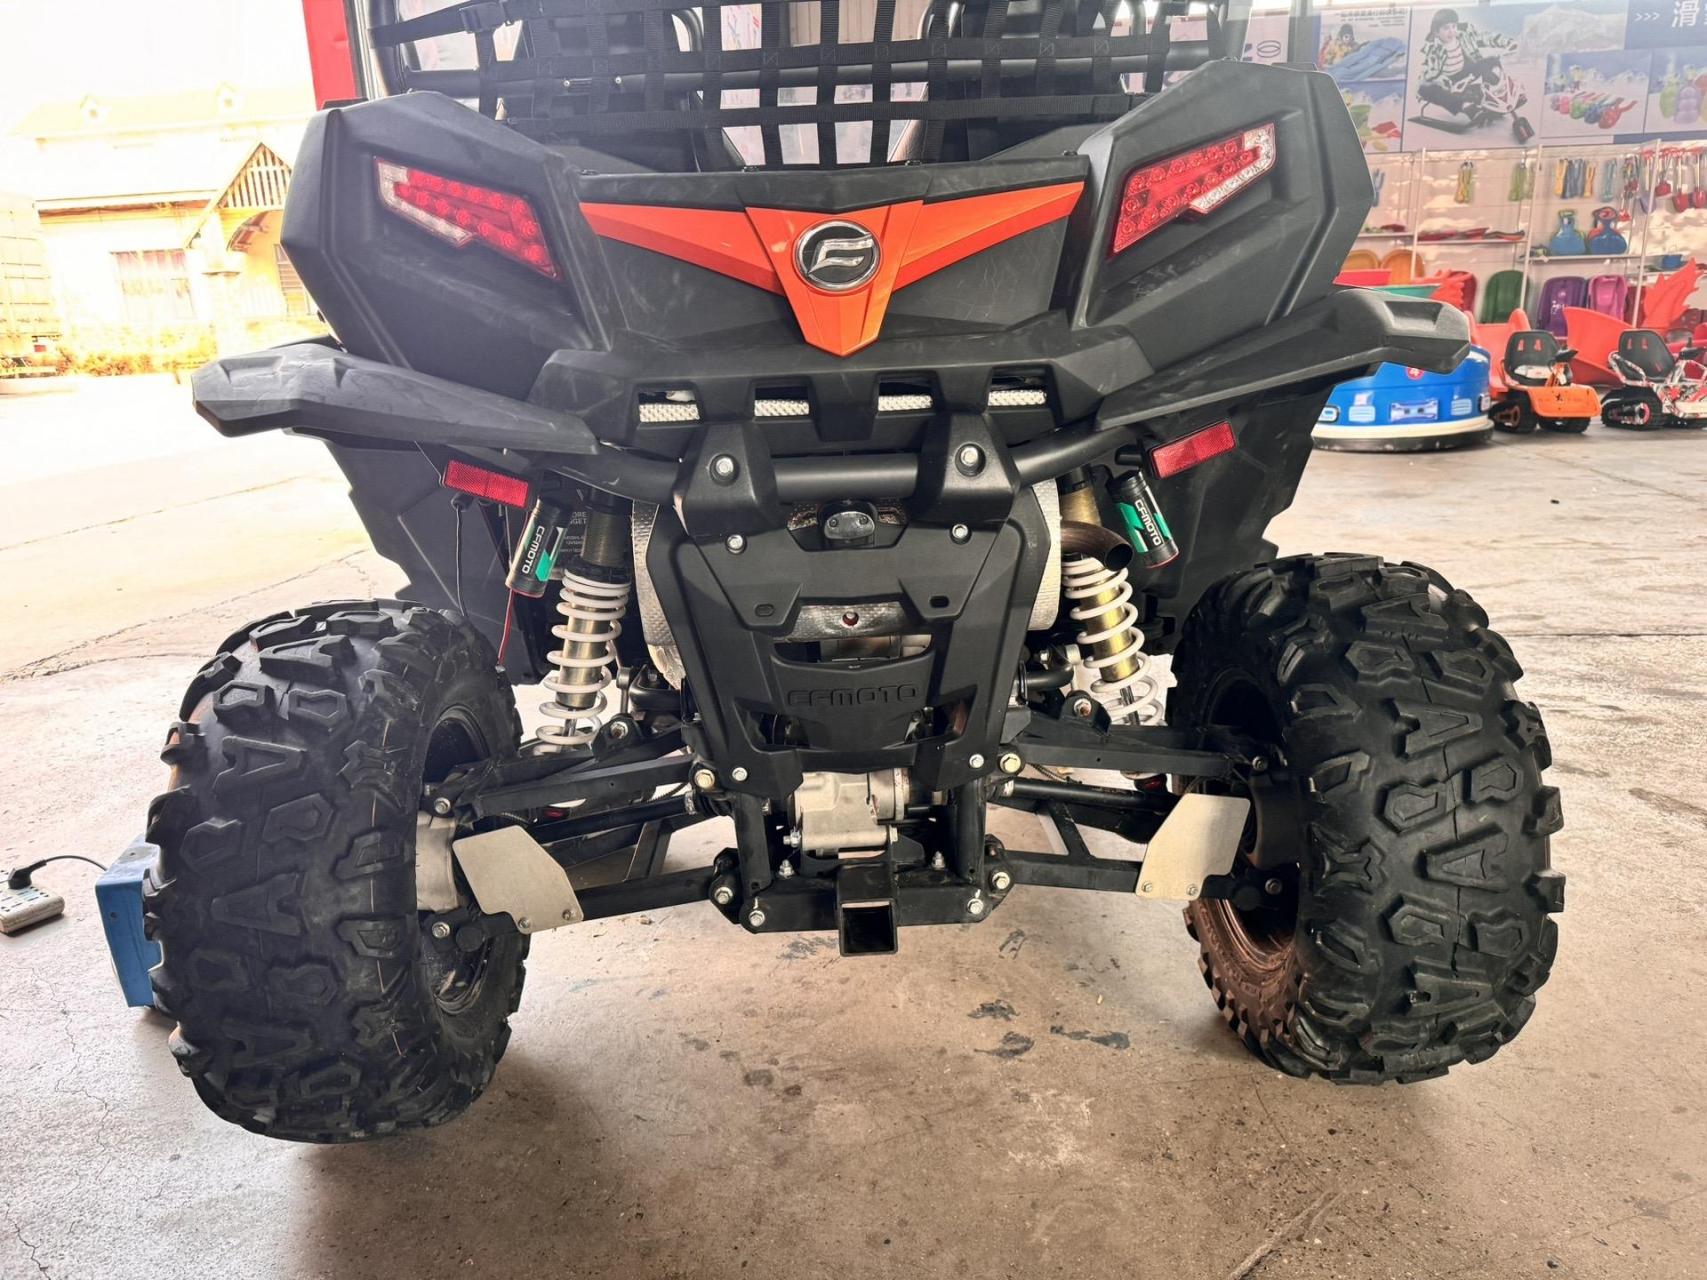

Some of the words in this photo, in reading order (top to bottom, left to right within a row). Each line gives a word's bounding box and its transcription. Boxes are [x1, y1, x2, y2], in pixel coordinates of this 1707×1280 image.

[1672, 0, 1707, 28] 滑
[1135, 499, 1162, 546] CFMOTO
[521, 525, 545, 574] CFMOTO
[787, 683, 917, 707] CFMOTO
